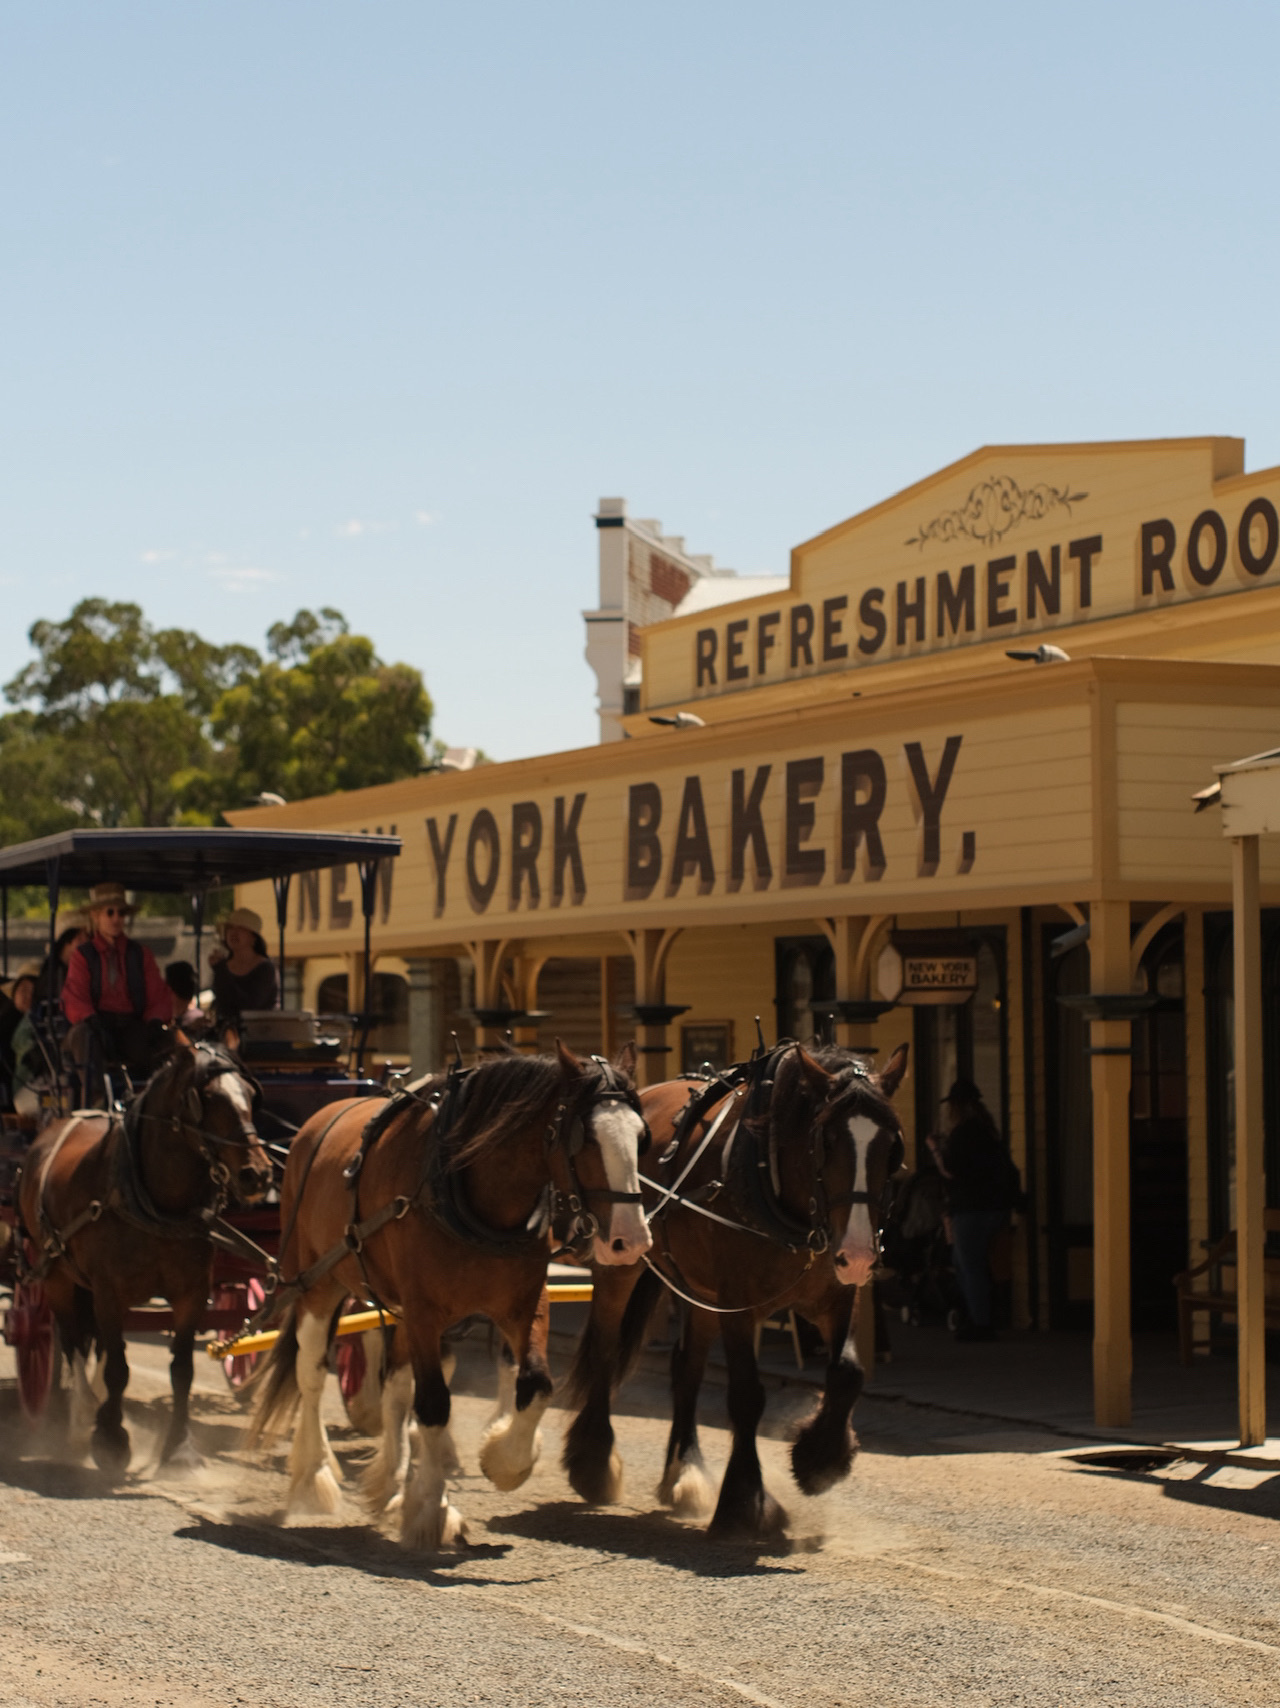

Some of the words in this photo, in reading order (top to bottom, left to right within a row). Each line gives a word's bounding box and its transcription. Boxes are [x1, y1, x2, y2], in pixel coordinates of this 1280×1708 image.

[696, 534, 1104, 689] REFRESHMENT
[1140, 496, 1280, 597] ROO
[425, 792, 588, 914] YORK
[626, 734, 976, 892] BAKERY.
[909, 962, 937, 972] NEW
[942, 962, 970, 972] YORK
[911, 973, 969, 984] BAKERY
